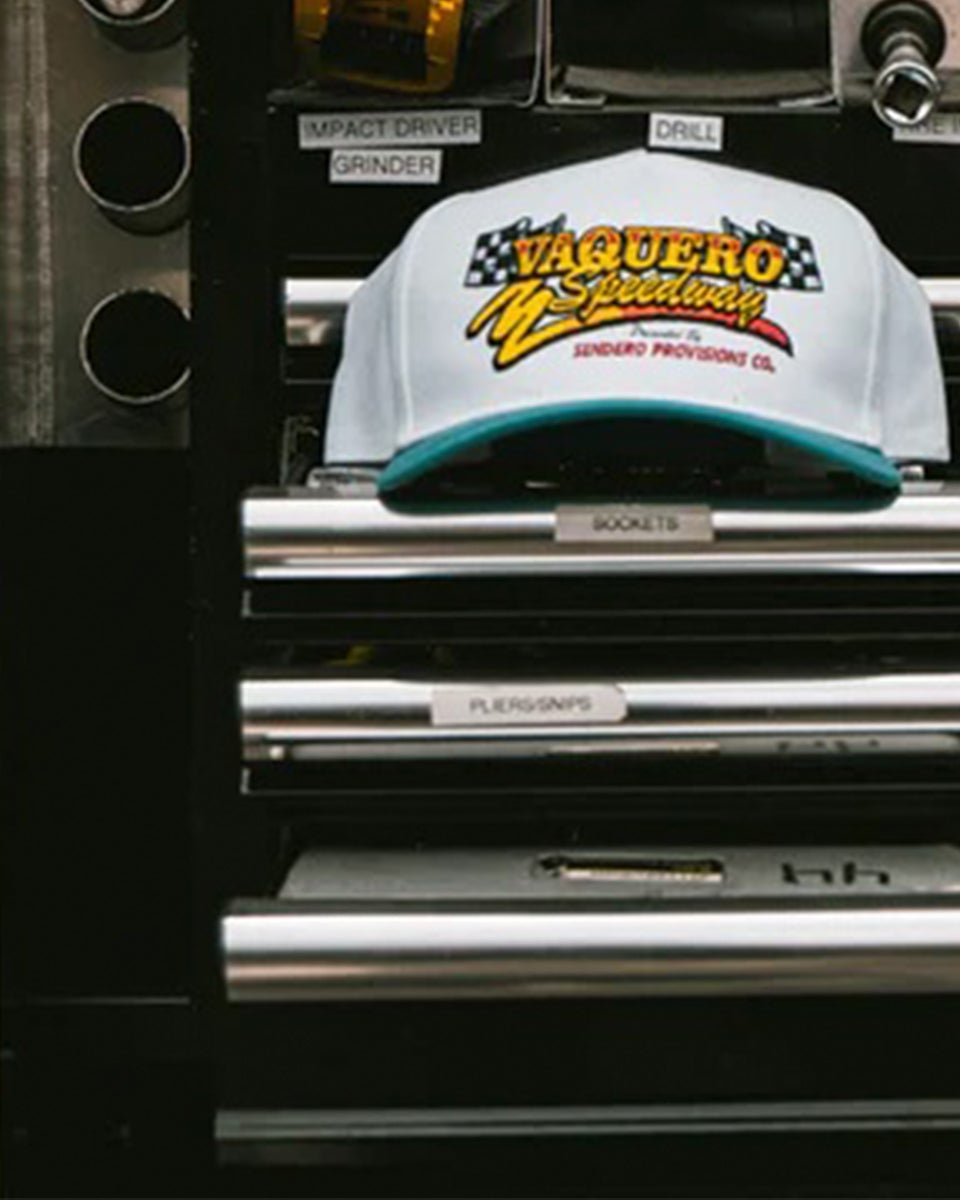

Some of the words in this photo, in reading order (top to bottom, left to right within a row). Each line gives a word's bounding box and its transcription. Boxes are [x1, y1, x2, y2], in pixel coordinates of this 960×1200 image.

[304, 119, 387, 141] IMPACT
[398, 115, 479, 137] DRIVER
[655, 119, 717, 143] DRILL
[334, 154, 435, 175] GRINDER
[513, 226, 788, 284] VAQUERO
[550, 265, 766, 328] Speedway
[573, 341, 648, 360] SENDERO
[650, 341, 748, 367] PROVISIONS
